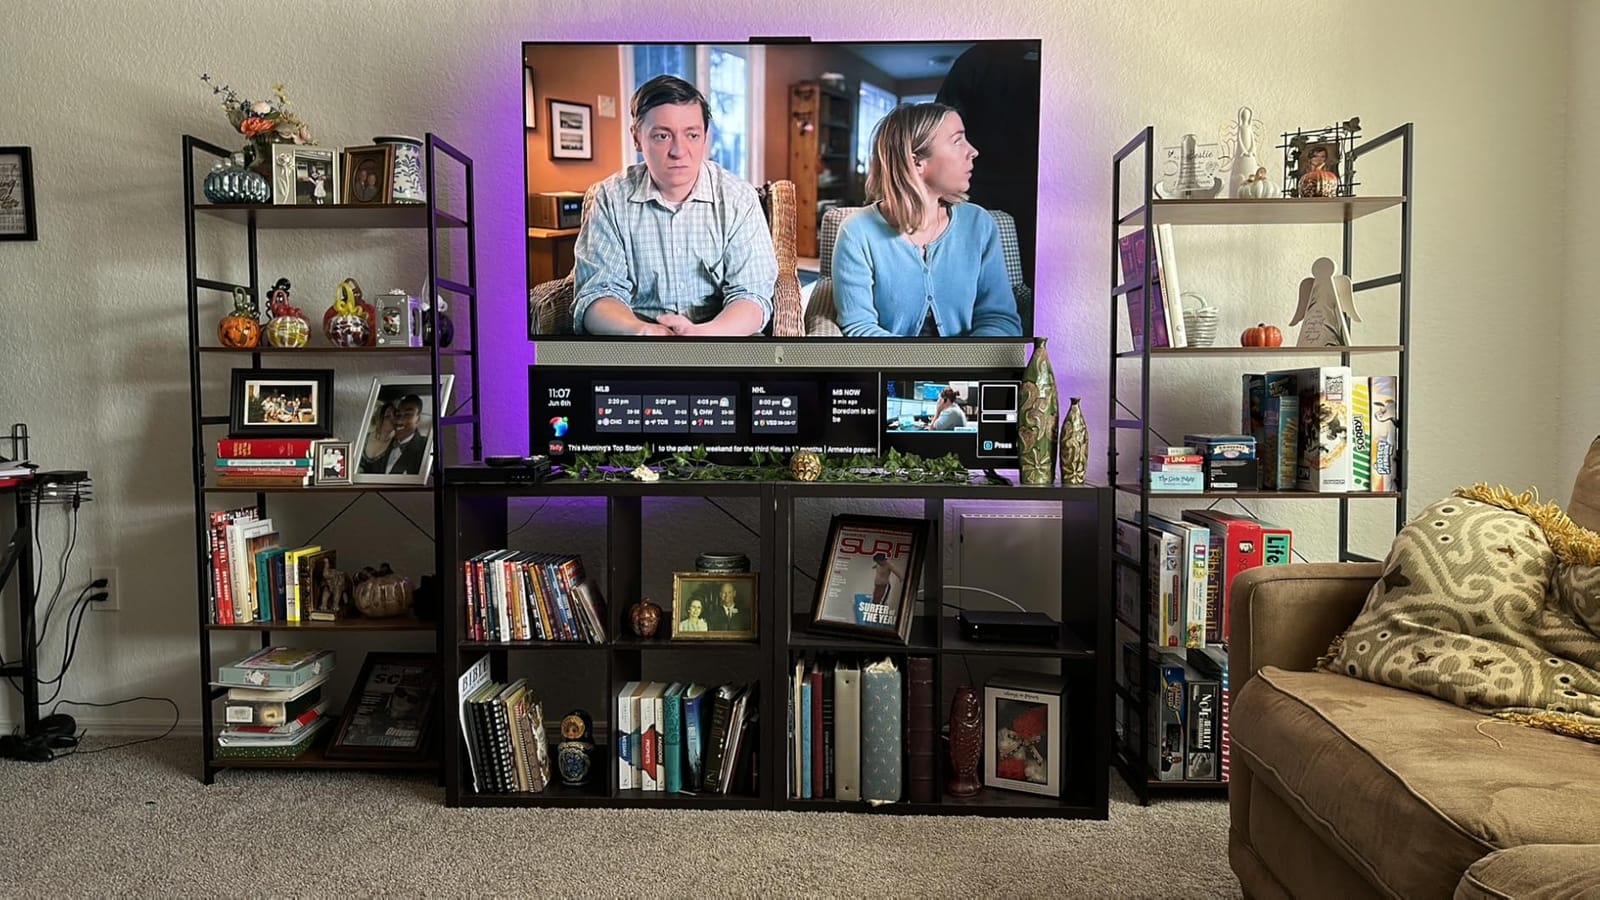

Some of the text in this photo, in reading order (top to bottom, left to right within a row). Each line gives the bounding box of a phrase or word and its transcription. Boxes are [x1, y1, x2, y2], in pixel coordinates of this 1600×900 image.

[548, 388, 571, 398] 11:07
[752, 386, 766, 394] NHL
[832, 407, 860, 415] Boredom
[582, 444, 611, 453] Morning's
[677, 445, 692, 453] polls
[994, 441, 1013, 450] Press
[1171, 455, 1186, 463] UNO
[1266, 536, 1285, 565] Life
[1193, 544, 1206, 580] LIFE
[1208, 547, 1221, 580] Bible
[1206, 581, 1218, 618] Trivia
[858, 601, 890, 615] SURFER
[862, 611, 877, 623] THE
[462, 657, 489, 692] BIBLE
